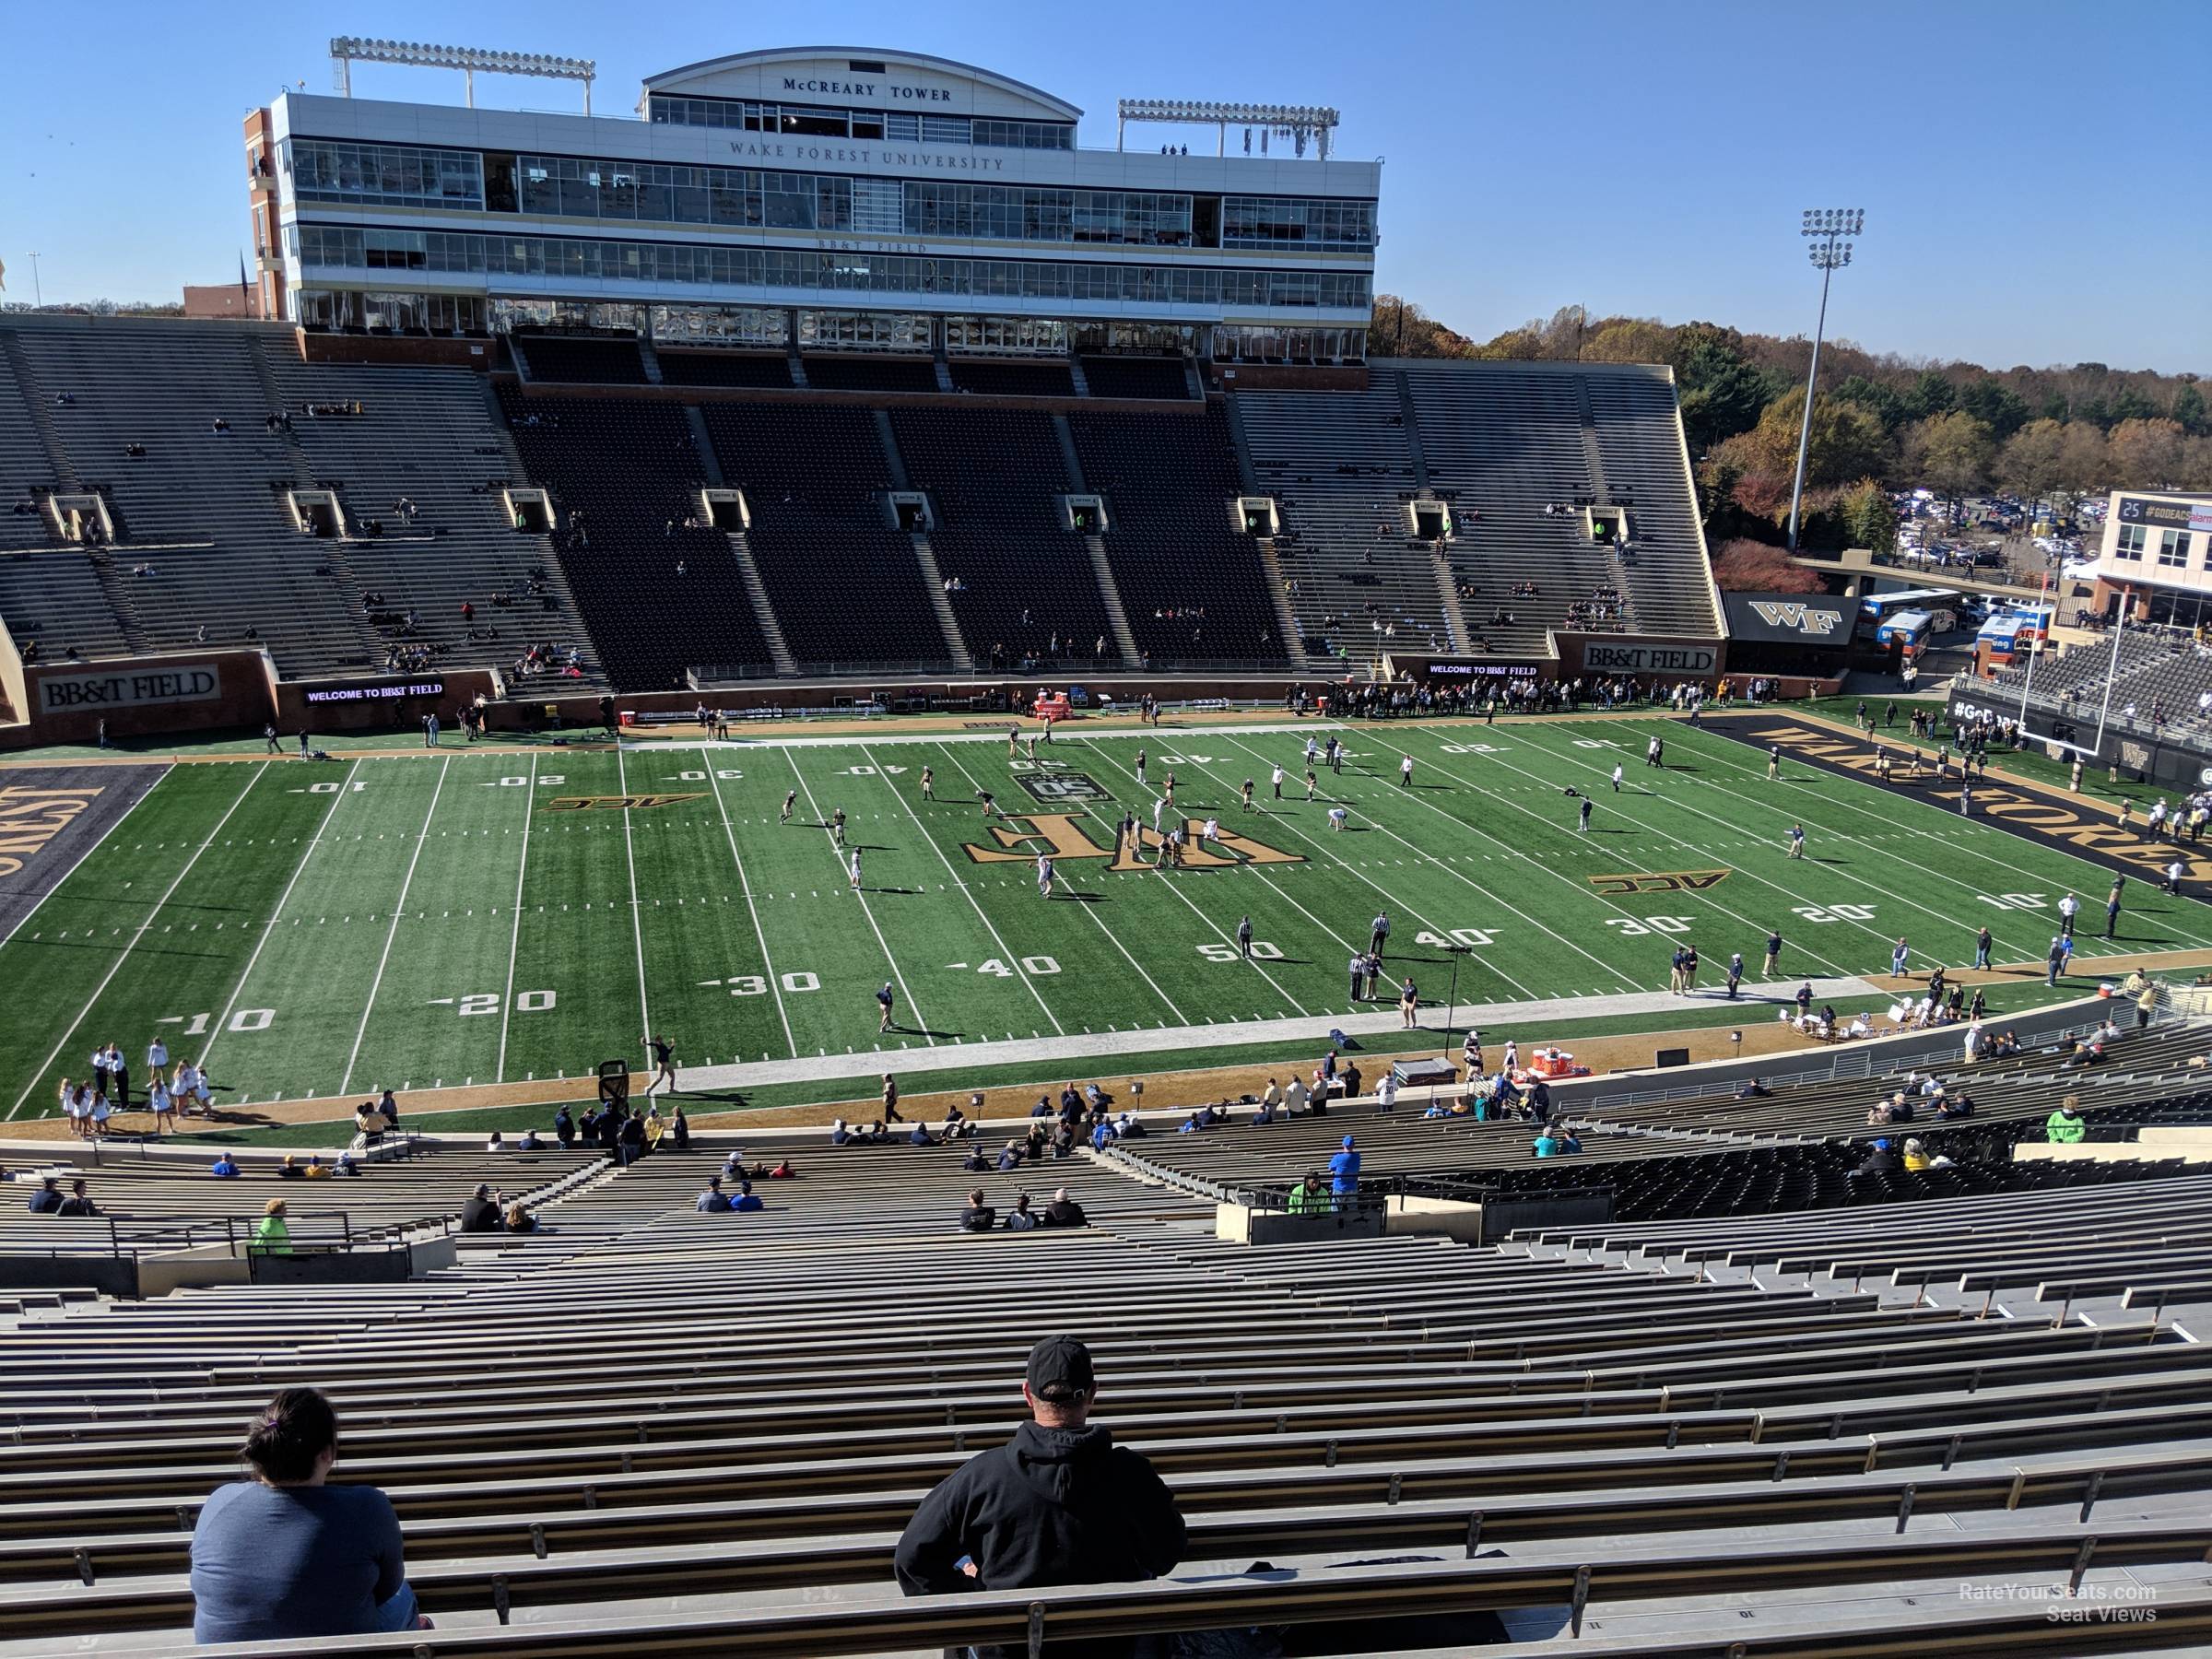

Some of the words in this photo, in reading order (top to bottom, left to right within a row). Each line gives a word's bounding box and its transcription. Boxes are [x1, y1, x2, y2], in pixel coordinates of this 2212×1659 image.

[783, 78, 876, 96] McCREARY
[890, 87, 951, 101] TOWER
[729, 142, 783, 157] WAKE
[797, 147, 870, 162] FOREST
[882, 152, 1004, 171] UNIVERSITY
[818, 240, 861, 250] BB&T
[877, 242, 926, 253] FIELD
[2123, 502, 2140, 517] 25
[2145, 506, 2192, 522] #GODEACS
[1748, 601, 1842, 634] WF
[1588, 647, 1647, 668] BB&T
[1649, 650, 1712, 670] FIELD
[1430, 665, 1472, 674] WELCOME
[1487, 666, 1508, 675] BB&T
[1510, 666, 1537, 676] FIELD
[44, 678, 126, 707] BB&T
[132, 671, 215, 700] FIELD
[308, 690, 363, 701] WELCOME
[364, 688, 380, 698] TO
[381, 687, 407, 698] BB&T
[409, 684, 442, 695] FIELD
[1439, 744, 1499, 753] 20
[1571, 739, 1621, 747] 10
[1159, 755, 1213, 764] 40
[679, 770, 744, 781] 30
[850, 765, 908, 775] 40
[309, 782, 368, 794] 10
[500, 774, 565, 786] 20
[959, 812, 1312, 872] WF
[1588, 869, 1735, 895] ACC
[1976, 893, 2049, 910] 10
[1791, 904, 1877, 923] 20
[1605, 916, 1692, 935] 30
[1415, 928, 1494, 947] 40
[1195, 941, 1285, 963] 50
[977, 956, 1062, 977] 40
[727, 971, 821, 996] 30
[459, 990, 557, 1016] 20
[183, 1008, 276, 1035] 10
